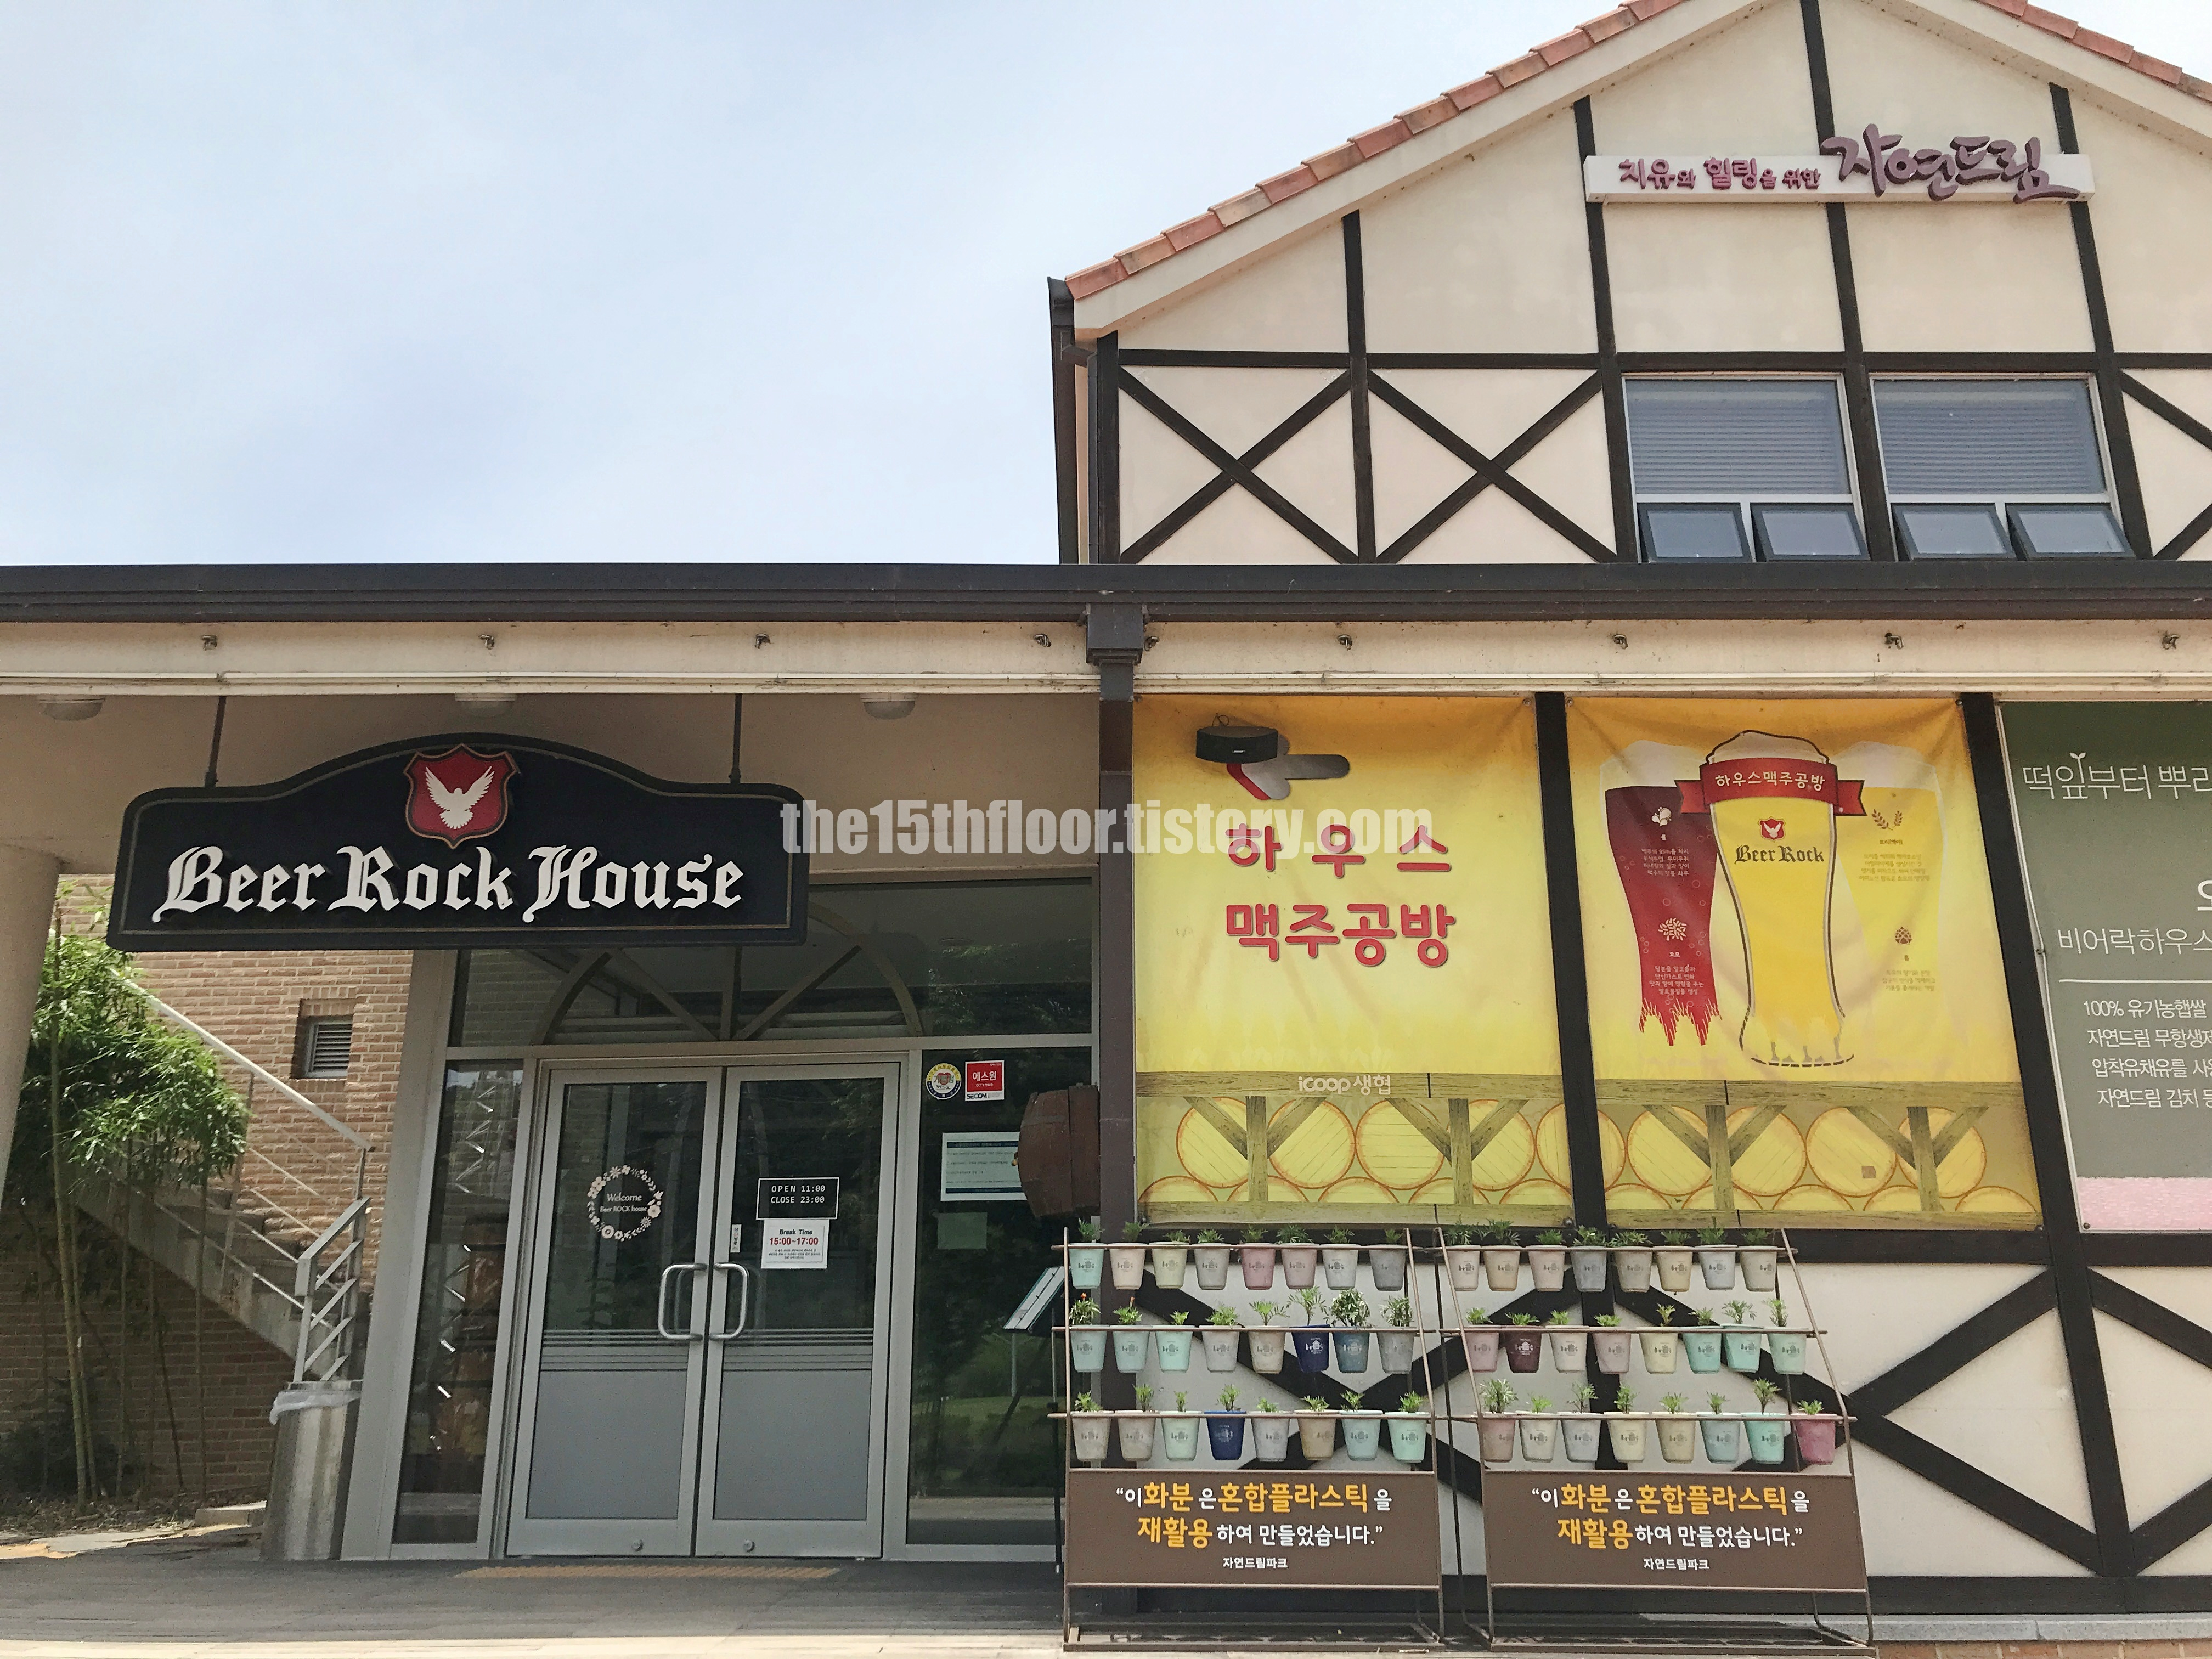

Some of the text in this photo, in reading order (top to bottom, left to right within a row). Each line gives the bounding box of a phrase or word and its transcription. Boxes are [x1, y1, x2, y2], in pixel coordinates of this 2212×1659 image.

[1618, 123, 2081, 204] 치유와 힐링을 위한 자연드림
[1714, 771, 1825, 792] 하우스맥주공방
[2023, 753, 2152, 800] 떡잎부터
[1734, 844, 1825, 864] Beer Rock
[151, 844, 744, 923] Beer Rock House
[1226, 903, 1456, 967] 맥주공방
[2084, 999, 2207, 1018] 100% 유기농햅쌀
[2087, 1029, 2151, 1048] 자연드림
[972, 1071, 996, 1081] 에스원
[2092, 1058, 2188, 1078] 압착유채유를
[1353, 1074, 1391, 1096] 생협
[2097, 1088, 2162, 1108] 자연드림
[2166, 1088, 2199, 1108] 김치
[607, 1192, 642, 1202] Welcome
[770, 1237, 819, 1245] 15:00~17:00
[1222, 1556, 1288, 1569] 자연드림파크
[1643, 1558, 1709, 1571] 자연드림파크
